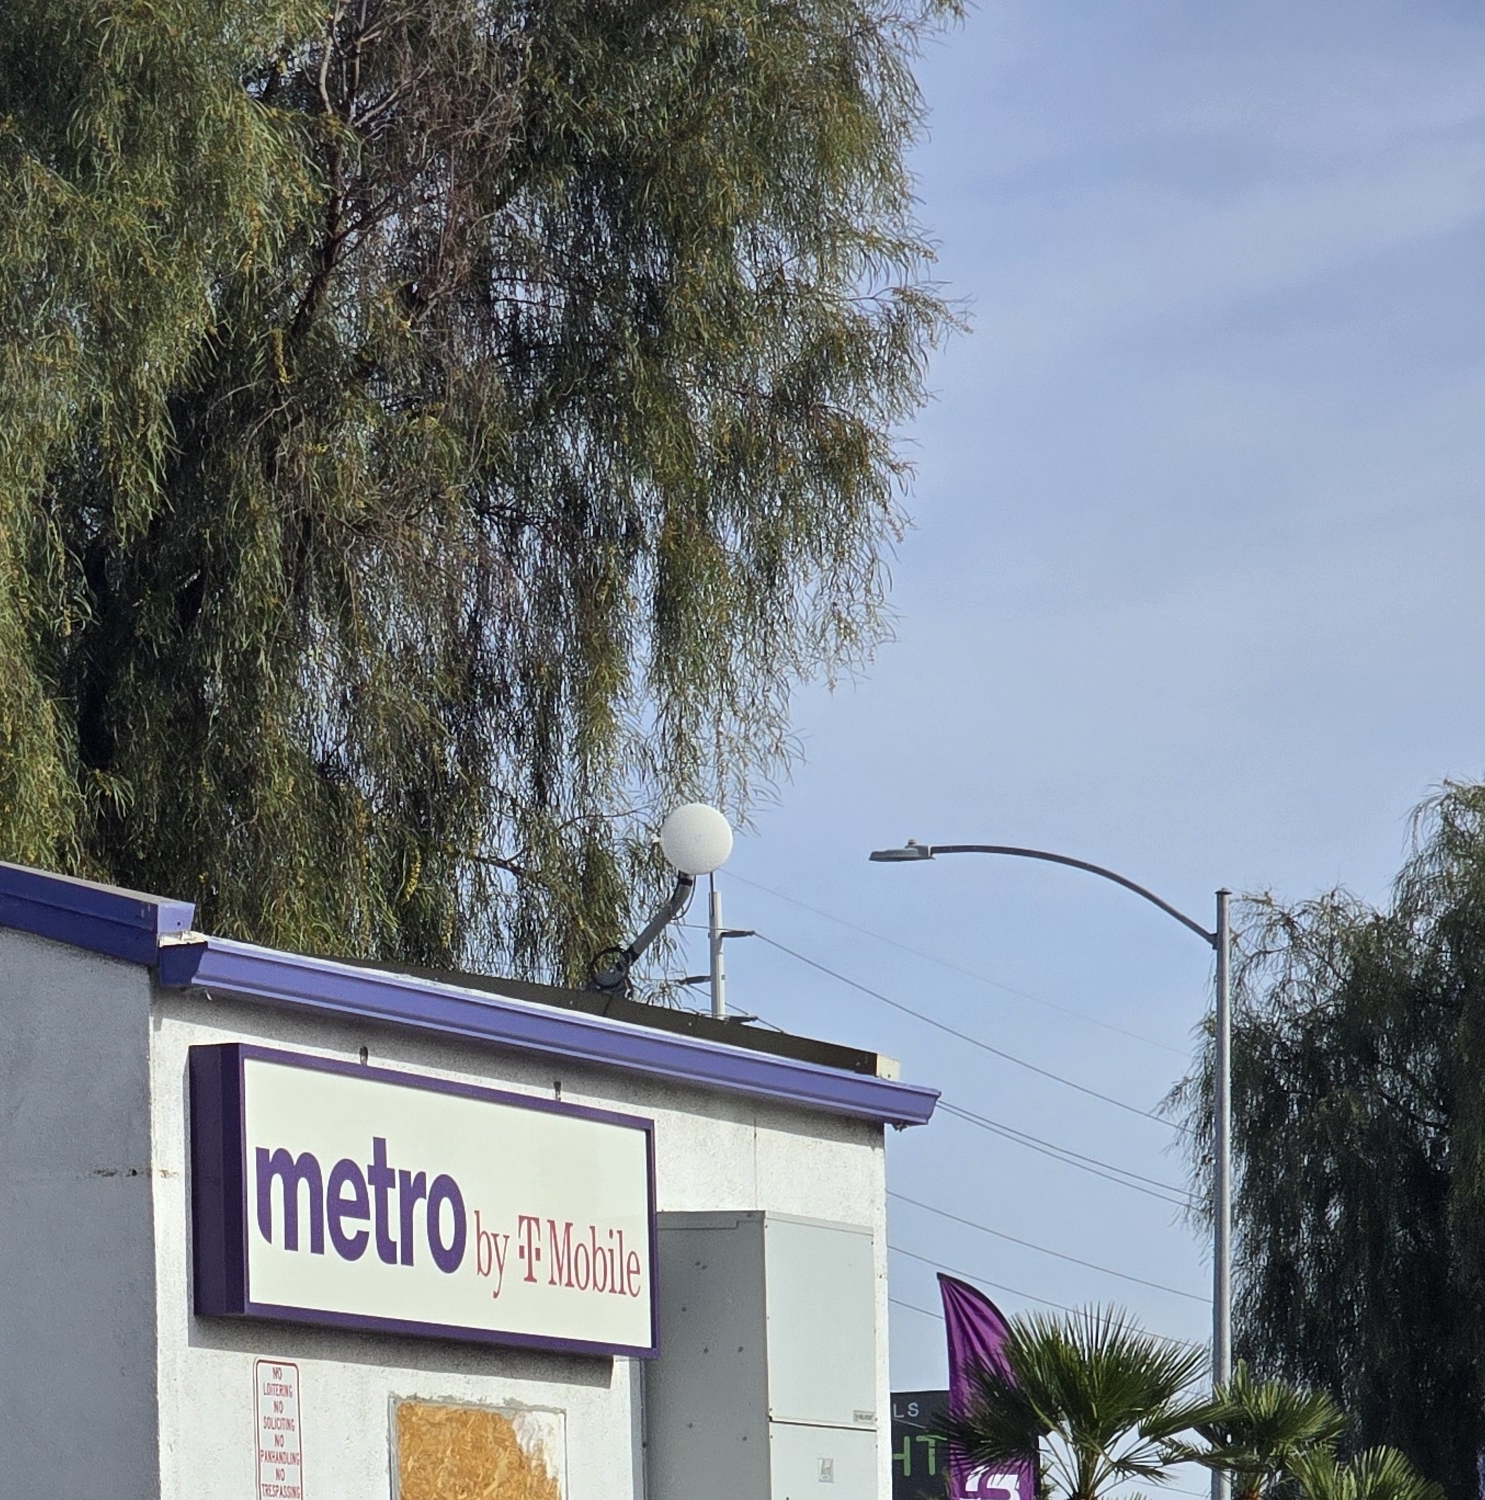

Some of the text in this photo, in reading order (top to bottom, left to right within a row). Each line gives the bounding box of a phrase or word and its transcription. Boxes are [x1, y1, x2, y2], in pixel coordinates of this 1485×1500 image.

[255, 1136, 467, 1274] metro
[474, 1210, 510, 1299] by
[272, 1366, 283, 1381] NO
[263, 1382, 293, 1399] LOITERING
[273, 1400, 284, 1415] NO
[263, 1416, 295, 1432] SOLICITING
[274, 1433, 285, 1448] NO
[260, 1449, 300, 1466] PANHANDLING
[275, 1467, 286, 1482] NO
[261, 1483, 301, 1500] TRESPASSING
